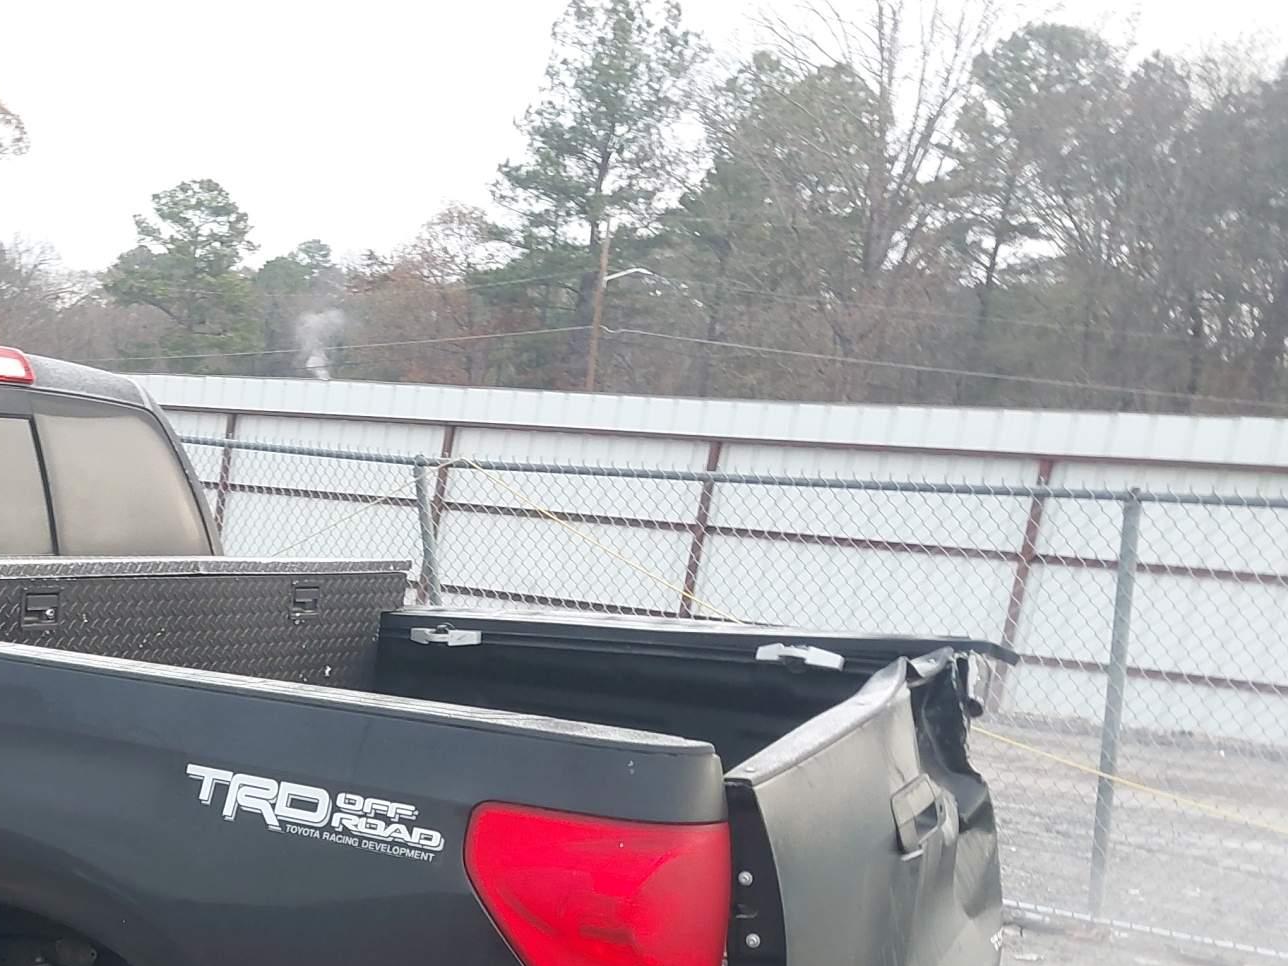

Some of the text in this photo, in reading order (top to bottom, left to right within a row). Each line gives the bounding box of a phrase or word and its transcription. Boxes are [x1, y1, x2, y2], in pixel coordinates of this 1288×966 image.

[185, 763, 332, 831] TRD
[336, 792, 419, 821] OFF
[285, 823, 435, 863] TOYOTA RACING DEVELOPMENT
[331, 812, 445, 851] ROAD
